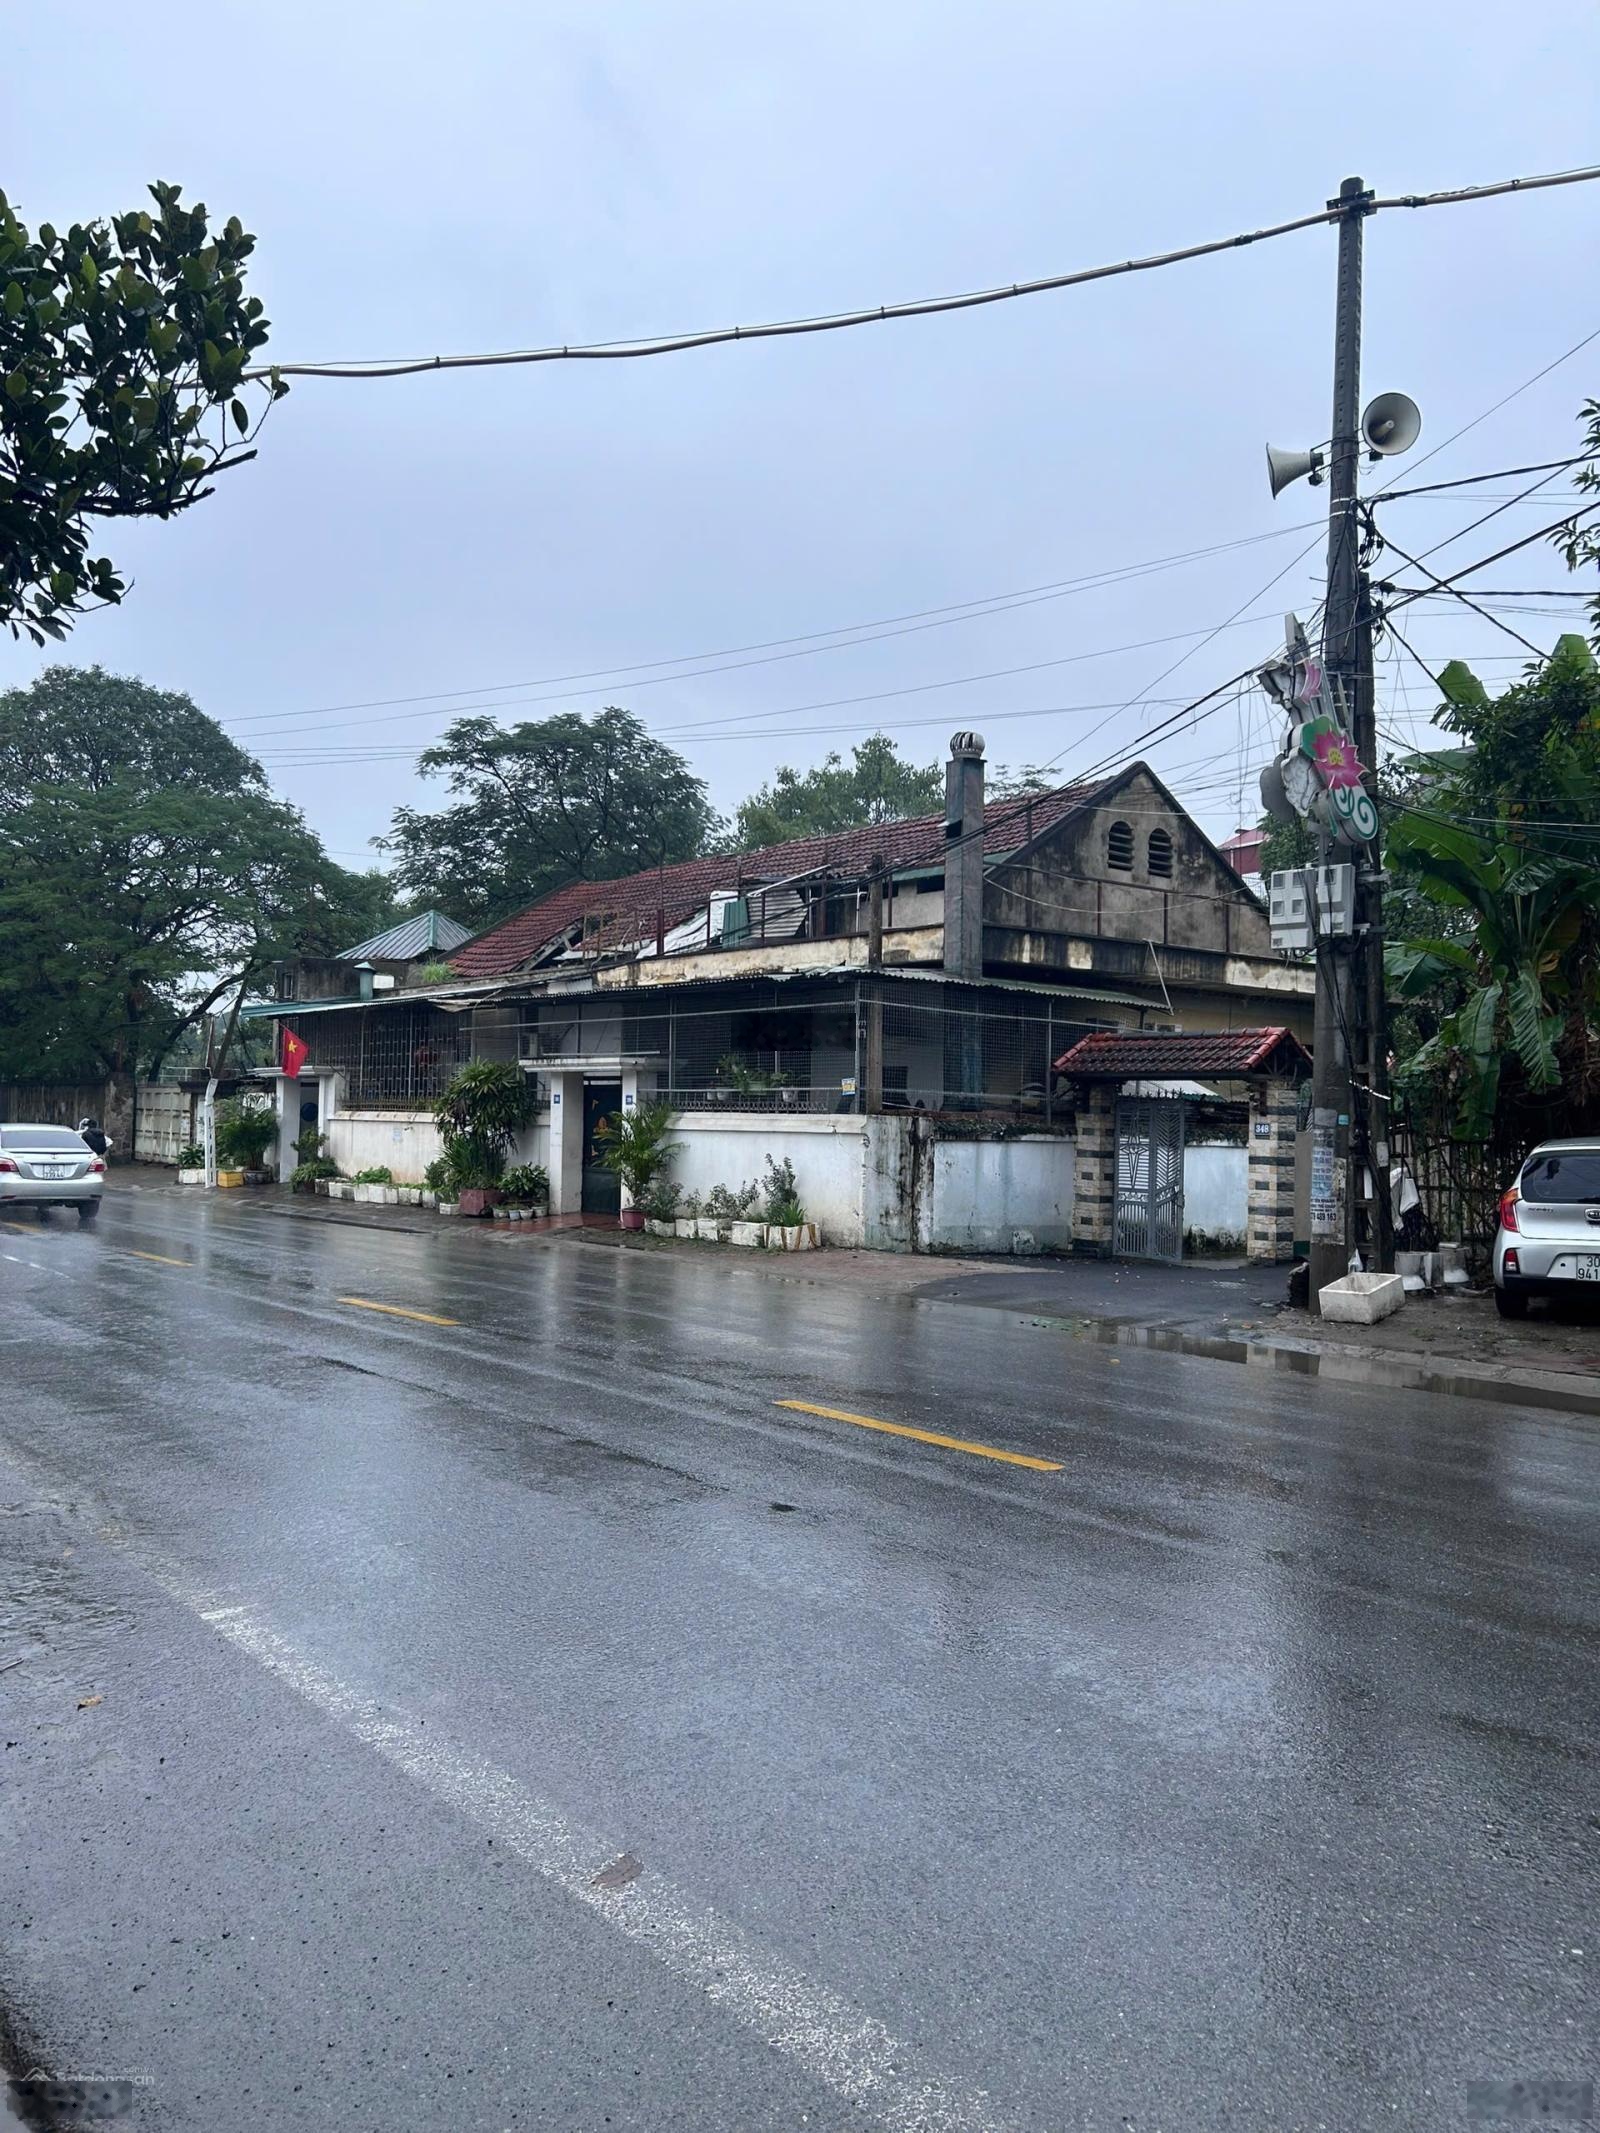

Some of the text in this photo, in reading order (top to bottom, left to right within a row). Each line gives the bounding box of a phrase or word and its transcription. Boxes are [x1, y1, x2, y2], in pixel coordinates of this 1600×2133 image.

[1255, 1124, 1270, 1133] 348
[1587, 1256, 1600, 1268] 30
[1578, 1268, 1599, 1280] 941
